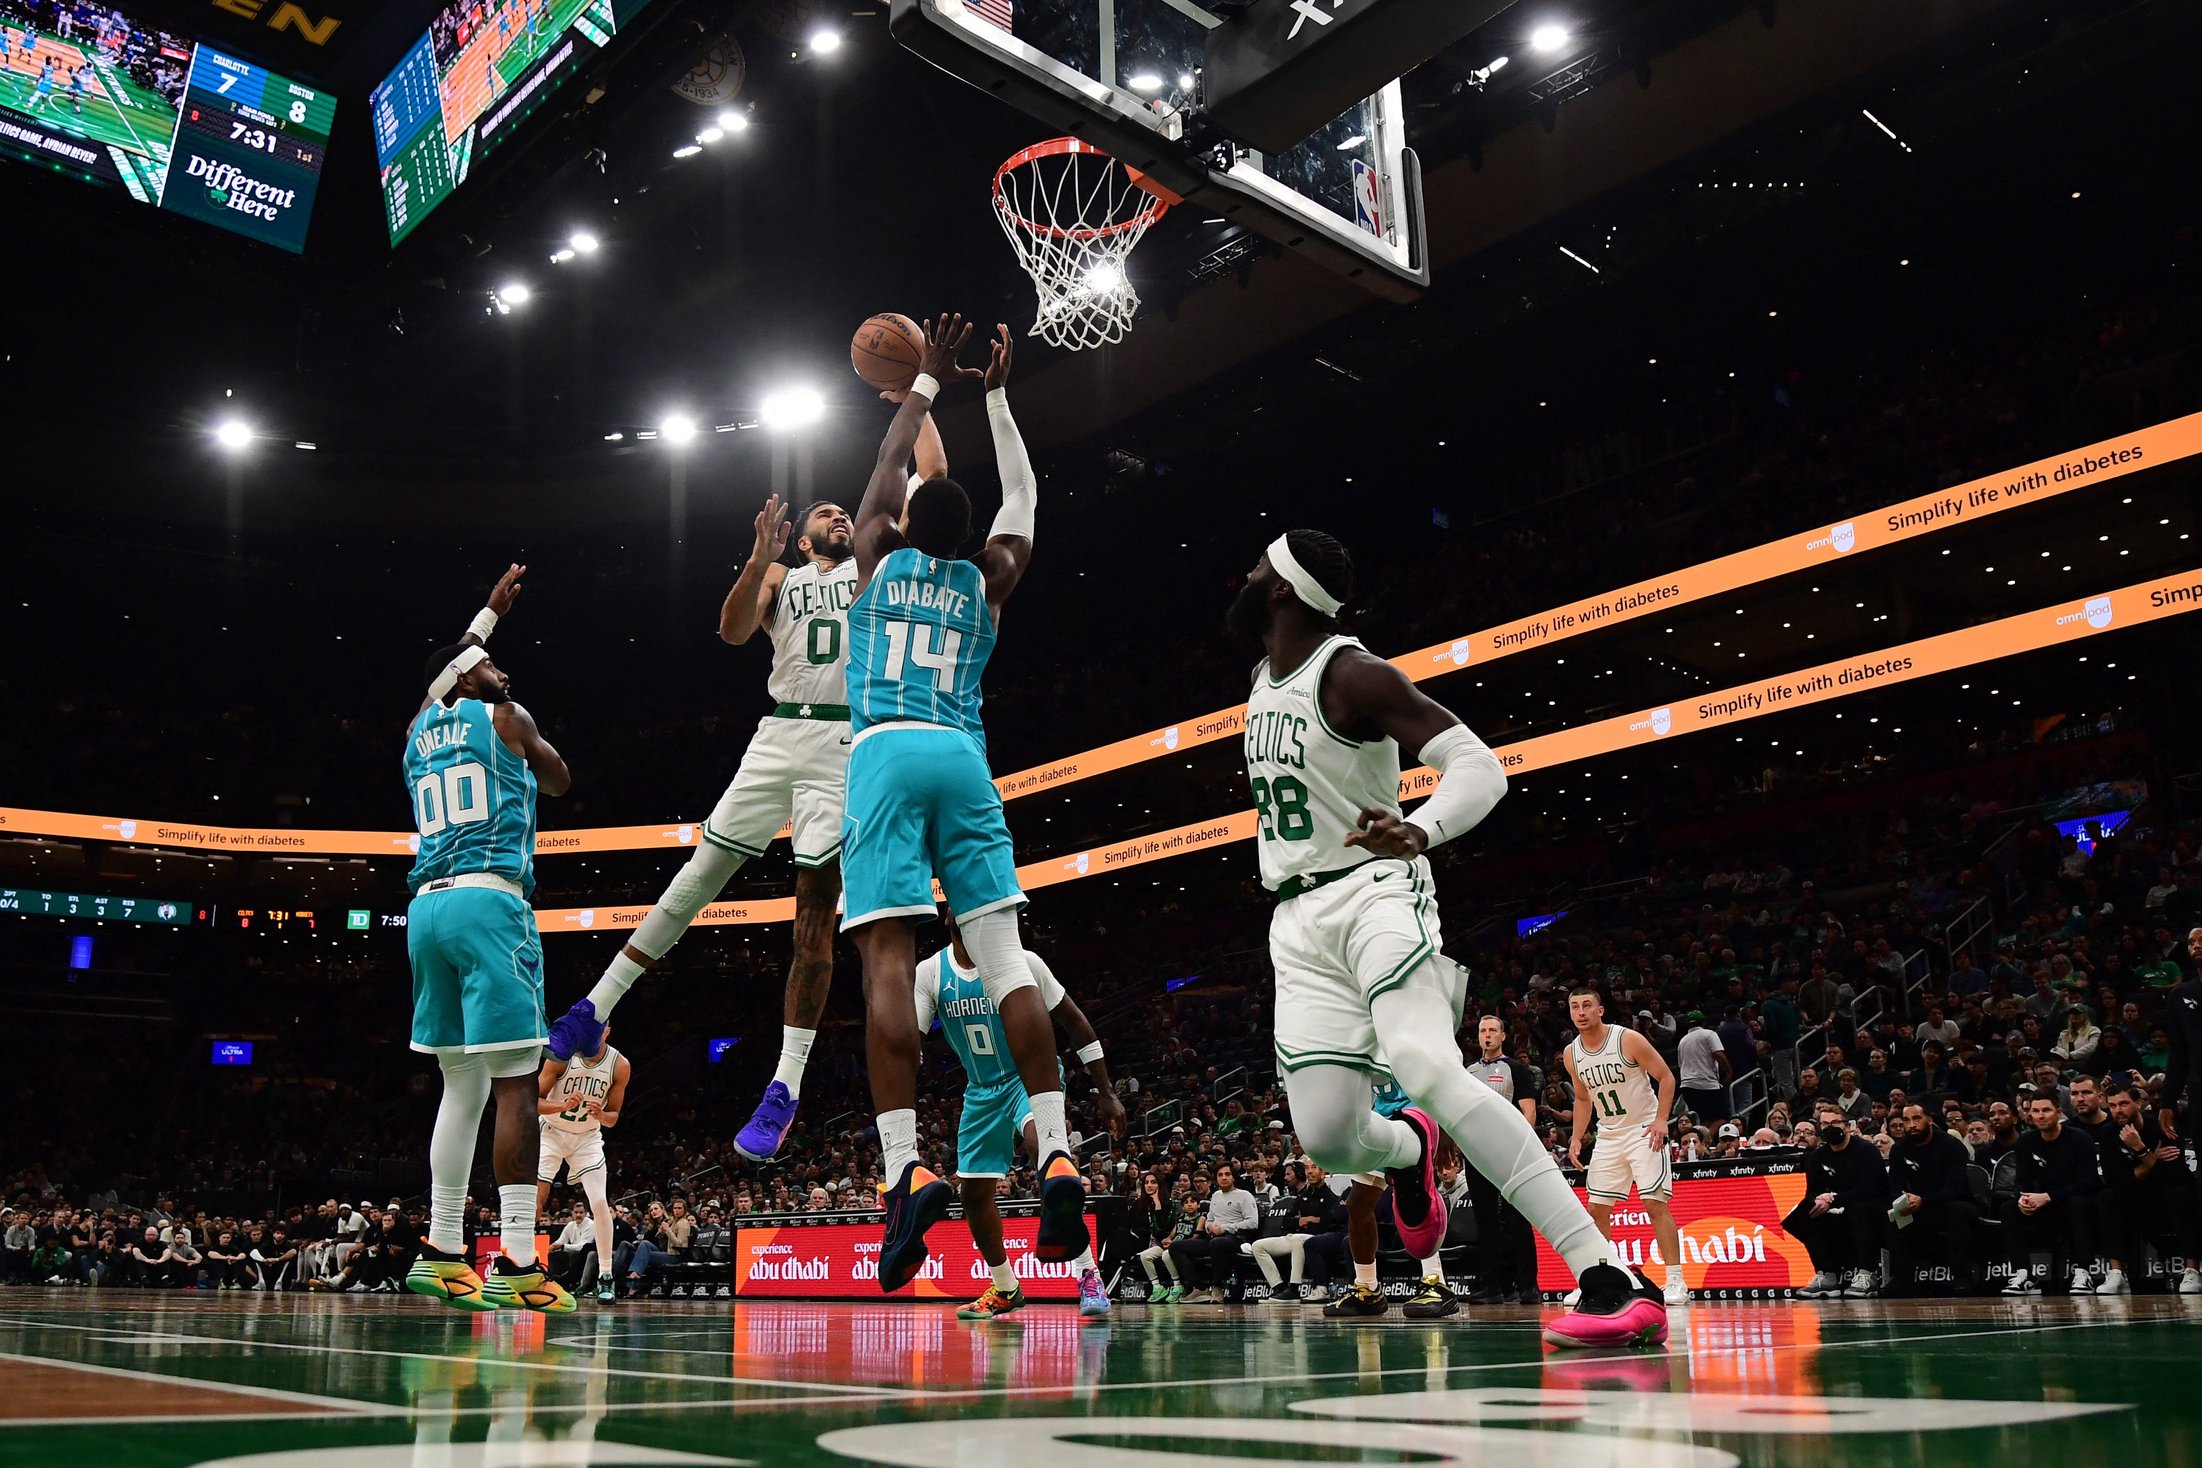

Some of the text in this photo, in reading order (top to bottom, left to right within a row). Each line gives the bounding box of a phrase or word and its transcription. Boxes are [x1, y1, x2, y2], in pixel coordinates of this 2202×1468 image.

[217, 72, 238, 94] 7
[678, 80, 720, 99] 5-1934
[289, 83, 315, 101] BOSTON
[191, 110, 200, 121] 8
[289, 101, 306, 123] 8
[229, 122, 277, 153] 7:31
[18, 128, 44, 148] GAME,
[69, 146, 98, 165] REYES!
[296, 149, 313, 162] 1st
[185, 155, 296, 208] Different
[226, 190, 278, 221] Here
[1888, 445, 2143, 532] Simplify life with diabetes
[1806, 526, 1855, 551] omnipod
[886, 580, 970, 619] DIABATE
[1493, 584, 1680, 650] Simplify life with diabetes
[2056, 600, 2112, 627] omnipod
[807, 618, 841, 665] 0
[884, 620, 963, 695] 14
[1433, 643, 1469, 665] omnipod
[1287, 686, 1311, 699] Amica
[1699, 654, 1912, 719] Simplify life with diabetes
[1196, 714, 1240, 737] Simplify
[1630, 711, 1671, 734] omnipod
[1150, 729, 1178, 748] omnipod
[1246, 711, 1307, 769] ELTICS
[1003, 763, 1078, 794] life with diabetes
[417, 762, 489, 838] 00
[157, 828, 306, 847] Simplify life with diabetes
[536, 836, 581, 849] diabetes
[1104, 824, 1229, 864] Simplify life with diabetes
[932, 884, 942, 895] it
[68, 895, 79, 903] STL
[95, 897, 108, 905] AST
[44, 902, 50, 912] 1
[69, 904, 77, 914] 3
[97, 906, 105, 916] 3
[124, 908, 132, 918] 7
[702, 906, 748, 920] diabetes
[199, 910, 206, 920] 8
[267, 910, 289, 921] 7:31
[350, 913, 368, 926] TD
[381, 915, 407, 927] 7:50
[612, 911, 649, 925] Simplif
[241, 918, 249, 928] 8
[944, 997, 1000, 1018] HORNET
[965, 1024, 995, 1055] 0
[1597, 1090, 1626, 1117] 11
[1693, 1168, 1718, 1179] xfinity
[1730, 1166, 1756, 1177] xfinity
[1768, 1163, 1795, 1174] xfinity
[1268, 1208, 1287, 1217] PIM
[854, 1240, 883, 1255] experi
[973, 1236, 1028, 1249] eence
[749, 1256, 779, 1280] abu
[970, 1257, 993, 1279] ab
[1914, 1266, 1954, 1284] jetBl
[2146, 1257, 2186, 1278] jetB
[1120, 1285, 1147, 1298] etBlue
[1242, 1284, 1273, 1300] jetBlu
[1449, 1281, 1471, 1296] Blue
[1543, 1292, 1549, 1300] G
[1557, 1292, 1564, 1300] G
[1704, 1290, 1711, 1299] G
[1720, 1290, 1727, 1298] G
[1735, 1290, 1742, 1298] G
[1752, 1289, 1759, 1297] G
[1767, 1289, 1775, 1297] G
[1784, 1288, 1791, 1297] G
